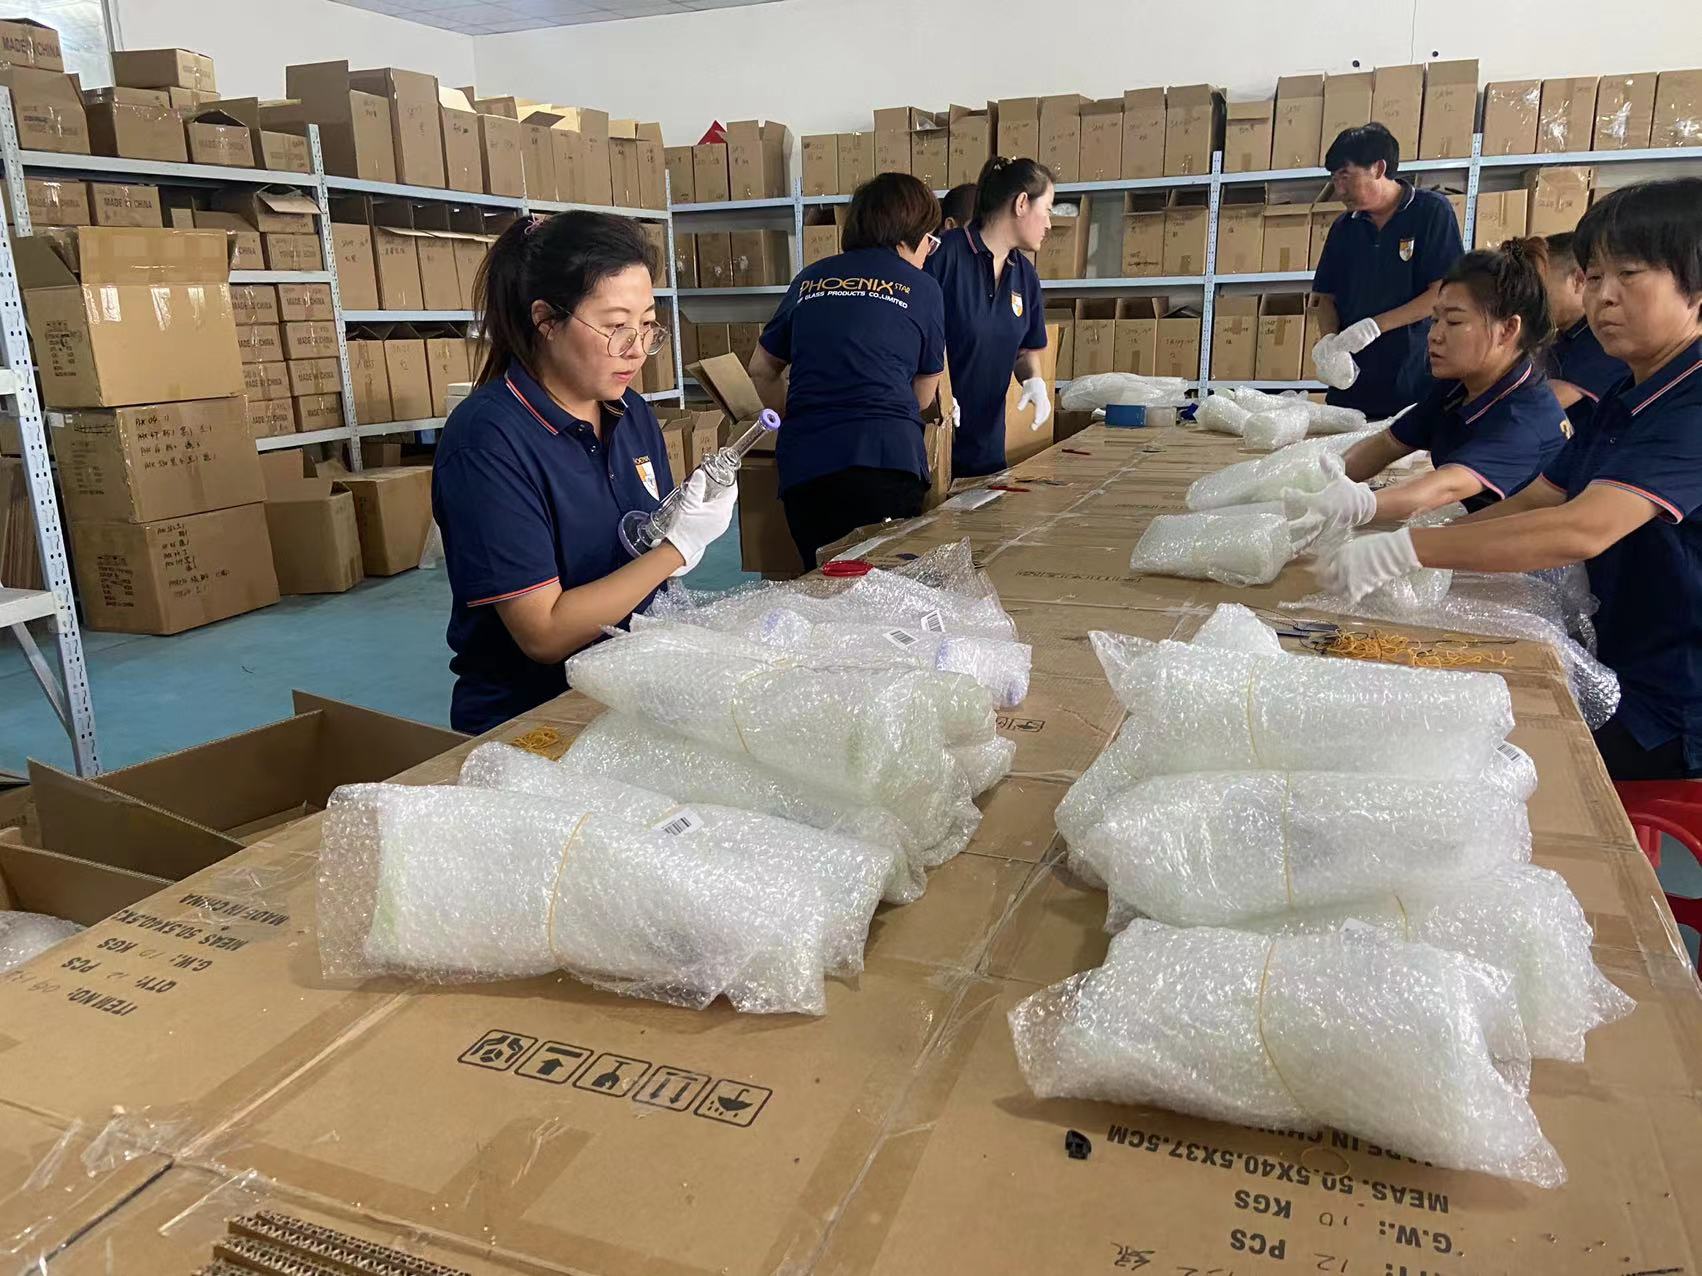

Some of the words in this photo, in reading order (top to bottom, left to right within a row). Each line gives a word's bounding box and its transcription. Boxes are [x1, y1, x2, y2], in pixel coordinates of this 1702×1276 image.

[103, 197, 123, 208] MADE
[133, 199, 153, 209] CHINA
[798, 277, 894, 298] PHOENIX
[894, 282, 911, 295] STAR
[804, 290, 825, 301] GLASS
[826, 290, 866, 298] PRODUCTS
[97, 937, 138, 954] KGS
[61, 956, 101, 973] PCS
[134, 975, 177, 993] QTY:
[1332, 1131, 1360, 1152] IN
[1106, 1124, 1354, 1195] 50.5X40.5X37.5CM
[1234, 1189, 1292, 1219] KGS
[1230, 1228, 1286, 1260] PCS
[1379, 1220, 1453, 1254] G.W.:
[1313, 1252, 1349, 1273] 12
